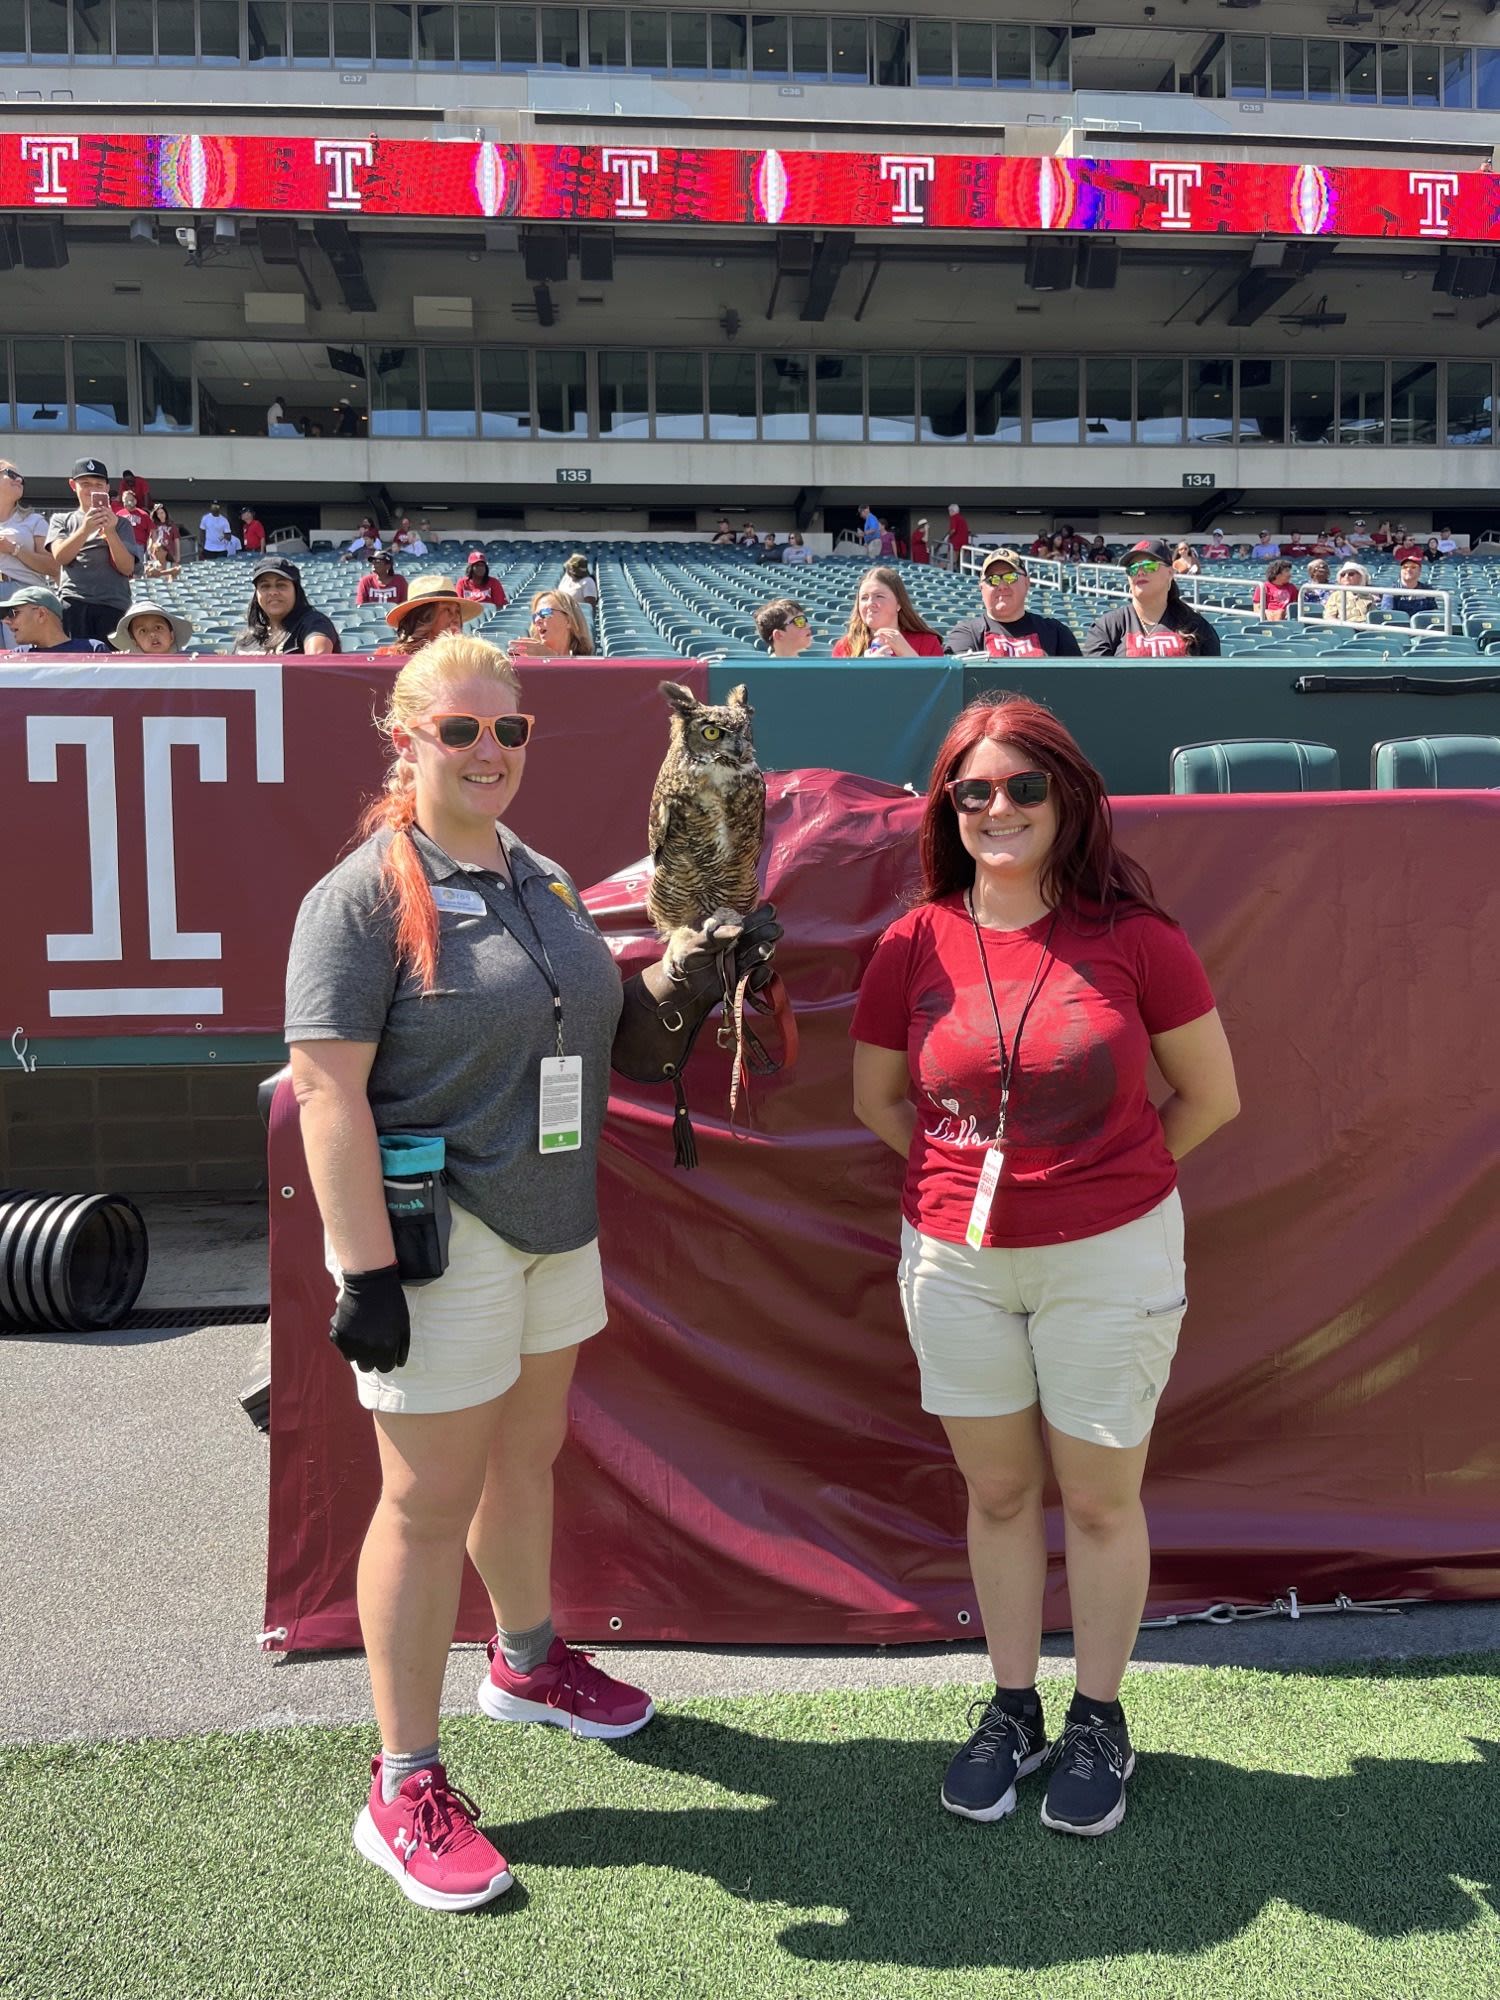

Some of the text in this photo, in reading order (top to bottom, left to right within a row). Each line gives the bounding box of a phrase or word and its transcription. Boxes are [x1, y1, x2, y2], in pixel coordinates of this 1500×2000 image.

[21, 136, 79, 203] T
[314, 140, 374, 209] T
[602, 148, 659, 217] T
[880, 156, 935, 224] T
[1150, 163, 1202, 229] T
[1408, 172, 1459, 236] T
[560, 470, 588, 482] 135
[1186, 474, 1213, 486] 134
[0, 663, 285, 1018] T
